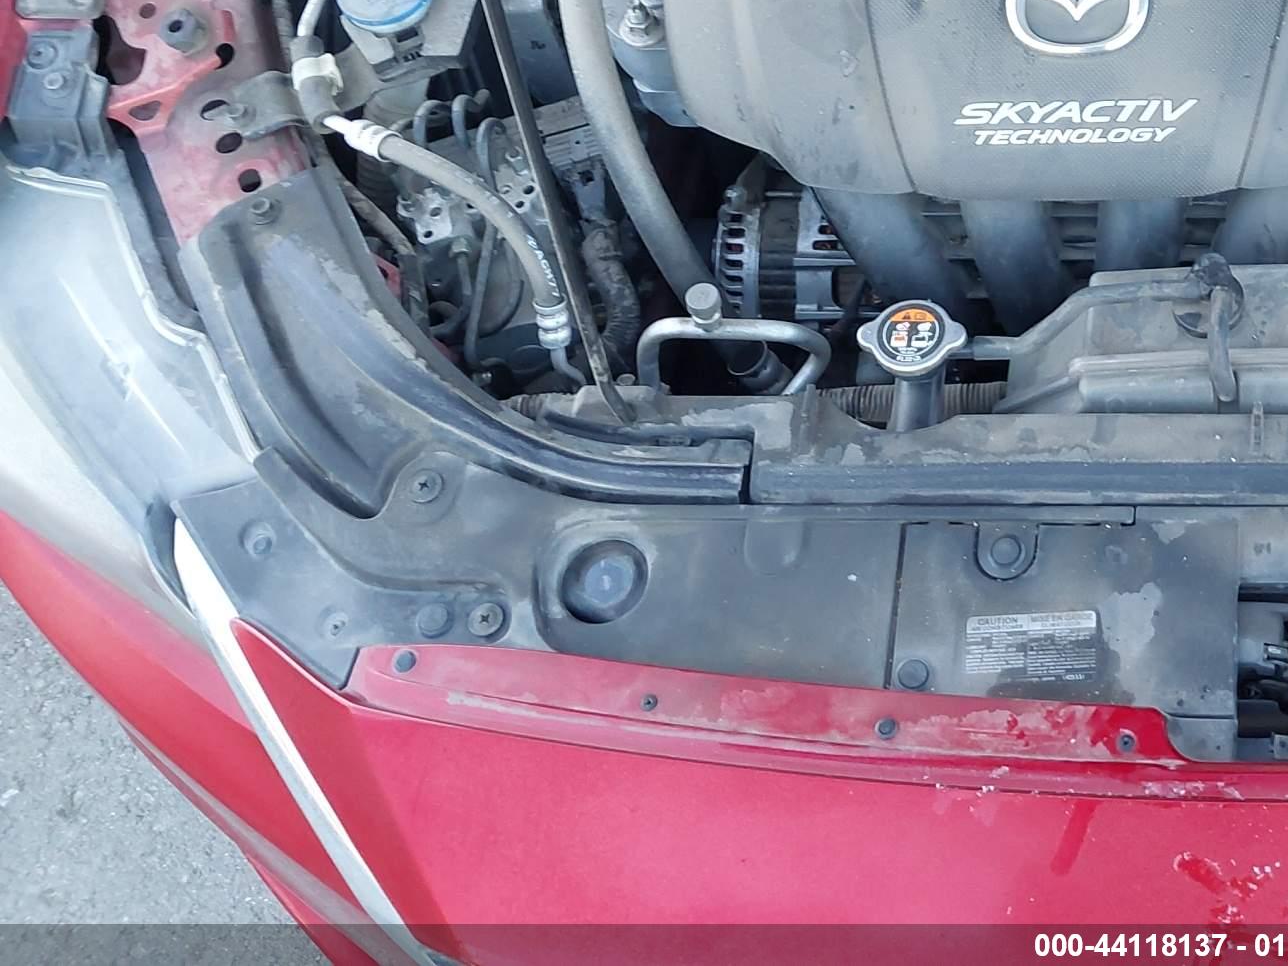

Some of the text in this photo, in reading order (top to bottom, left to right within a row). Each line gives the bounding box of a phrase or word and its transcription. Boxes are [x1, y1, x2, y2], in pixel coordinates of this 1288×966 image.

[953, 98, 1199, 126] SKYACTIV
[973, 127, 1177, 146] TECHNOLOGY
[977, 617, 1019, 626] CAUTION
